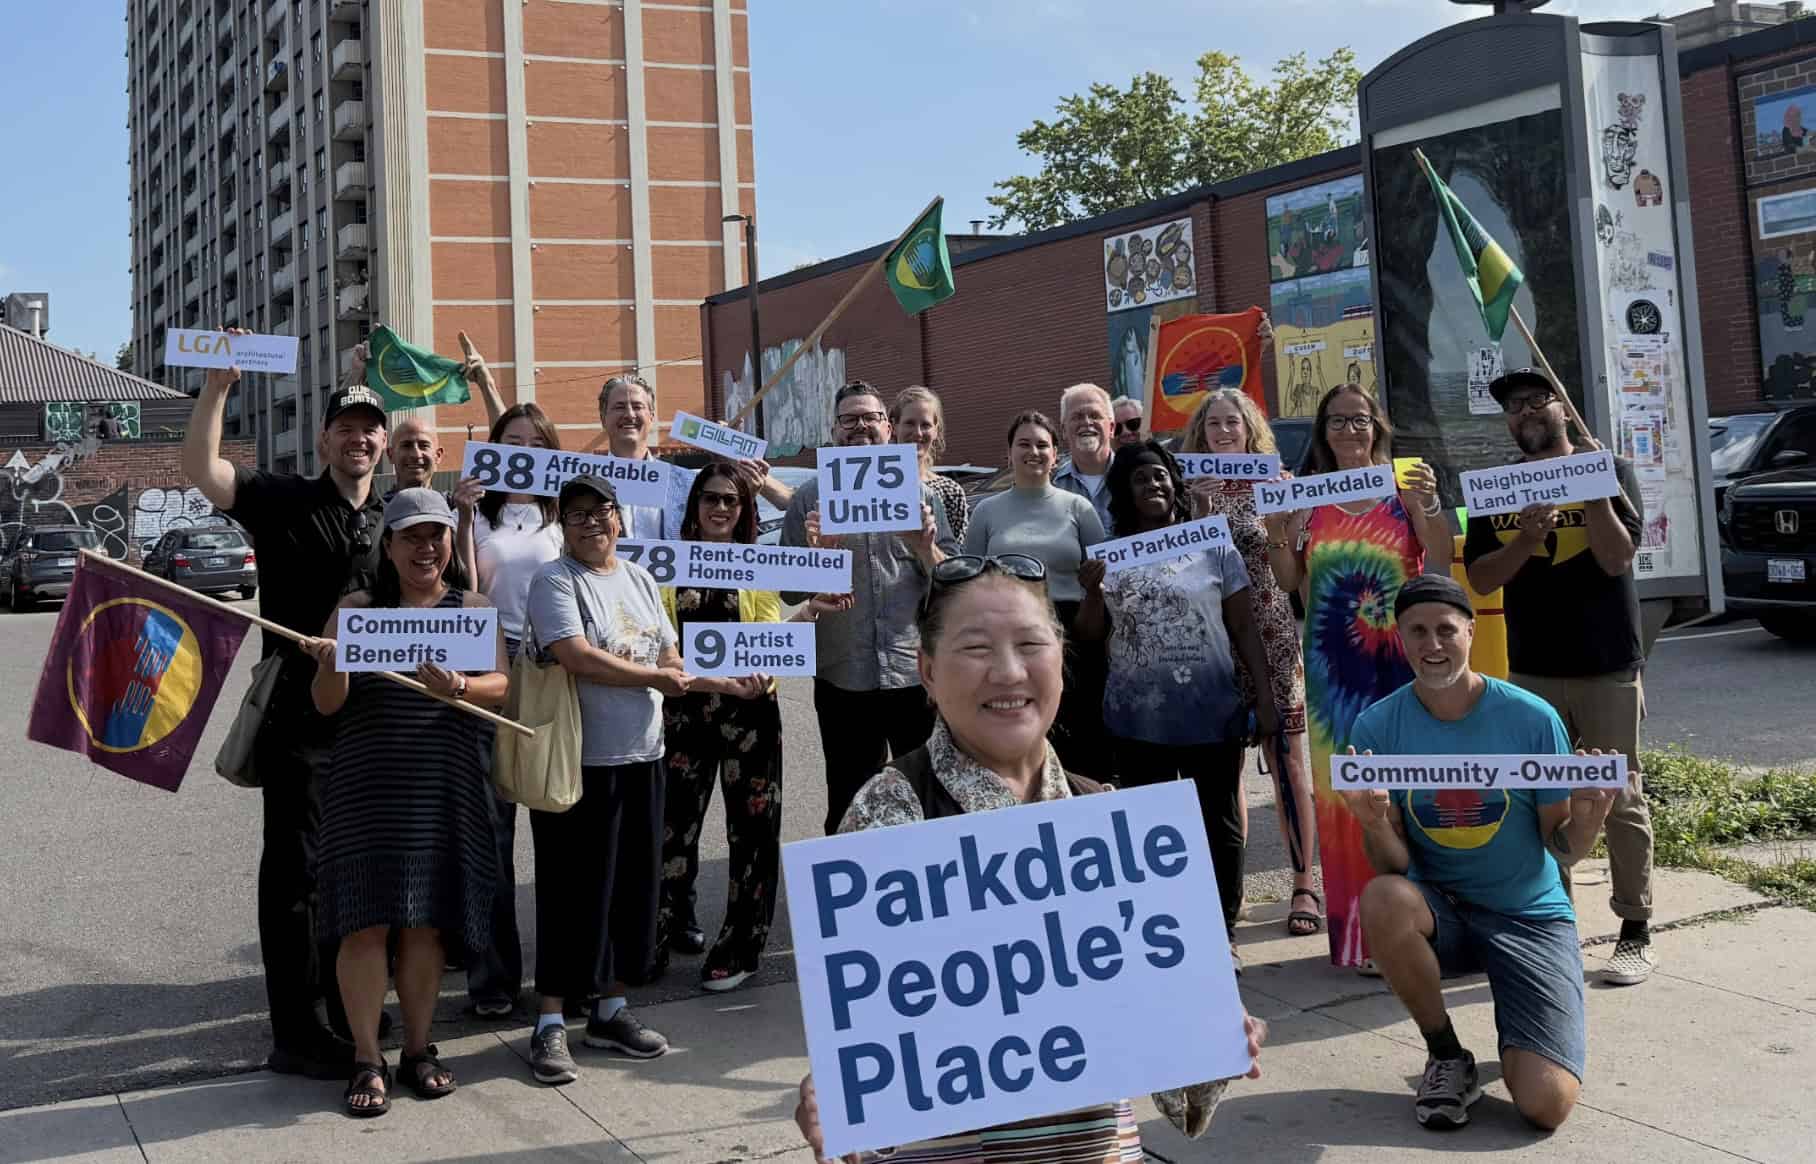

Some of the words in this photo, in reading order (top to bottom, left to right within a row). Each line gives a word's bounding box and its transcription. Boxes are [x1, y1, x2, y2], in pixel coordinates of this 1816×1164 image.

[177, 333, 232, 356] LGA
[701, 423, 758, 456] GILLAM
[470, 449, 534, 489] 88
[546, 454, 660, 483] Affordable
[825, 455, 905, 491] 175
[1200, 459, 1269, 475] Clare's
[1469, 458, 1608, 492] Neighbourhood
[1261, 487, 1286, 505] by
[1292, 471, 1384, 499] Parkdale
[1473, 491, 1517, 511] Land
[1520, 483, 1568, 502] Trust
[829, 498, 909, 524] Units
[690, 545, 844, 569] Rent-Controlled
[1094, 547, 1127, 564] For
[1131, 525, 1226, 558] Parkdale,
[688, 563, 755, 581] Homes
[346, 614, 488, 637] Community
[345, 644, 447, 663] Benefits
[694, 629, 726, 669] 9
[734, 631, 794, 648] Artist
[734, 650, 806, 667] Homes
[1340, 760, 1500, 787] Community
[812, 810, 1189, 938] Parkdale
[838, 1025, 1087, 1125] Place
